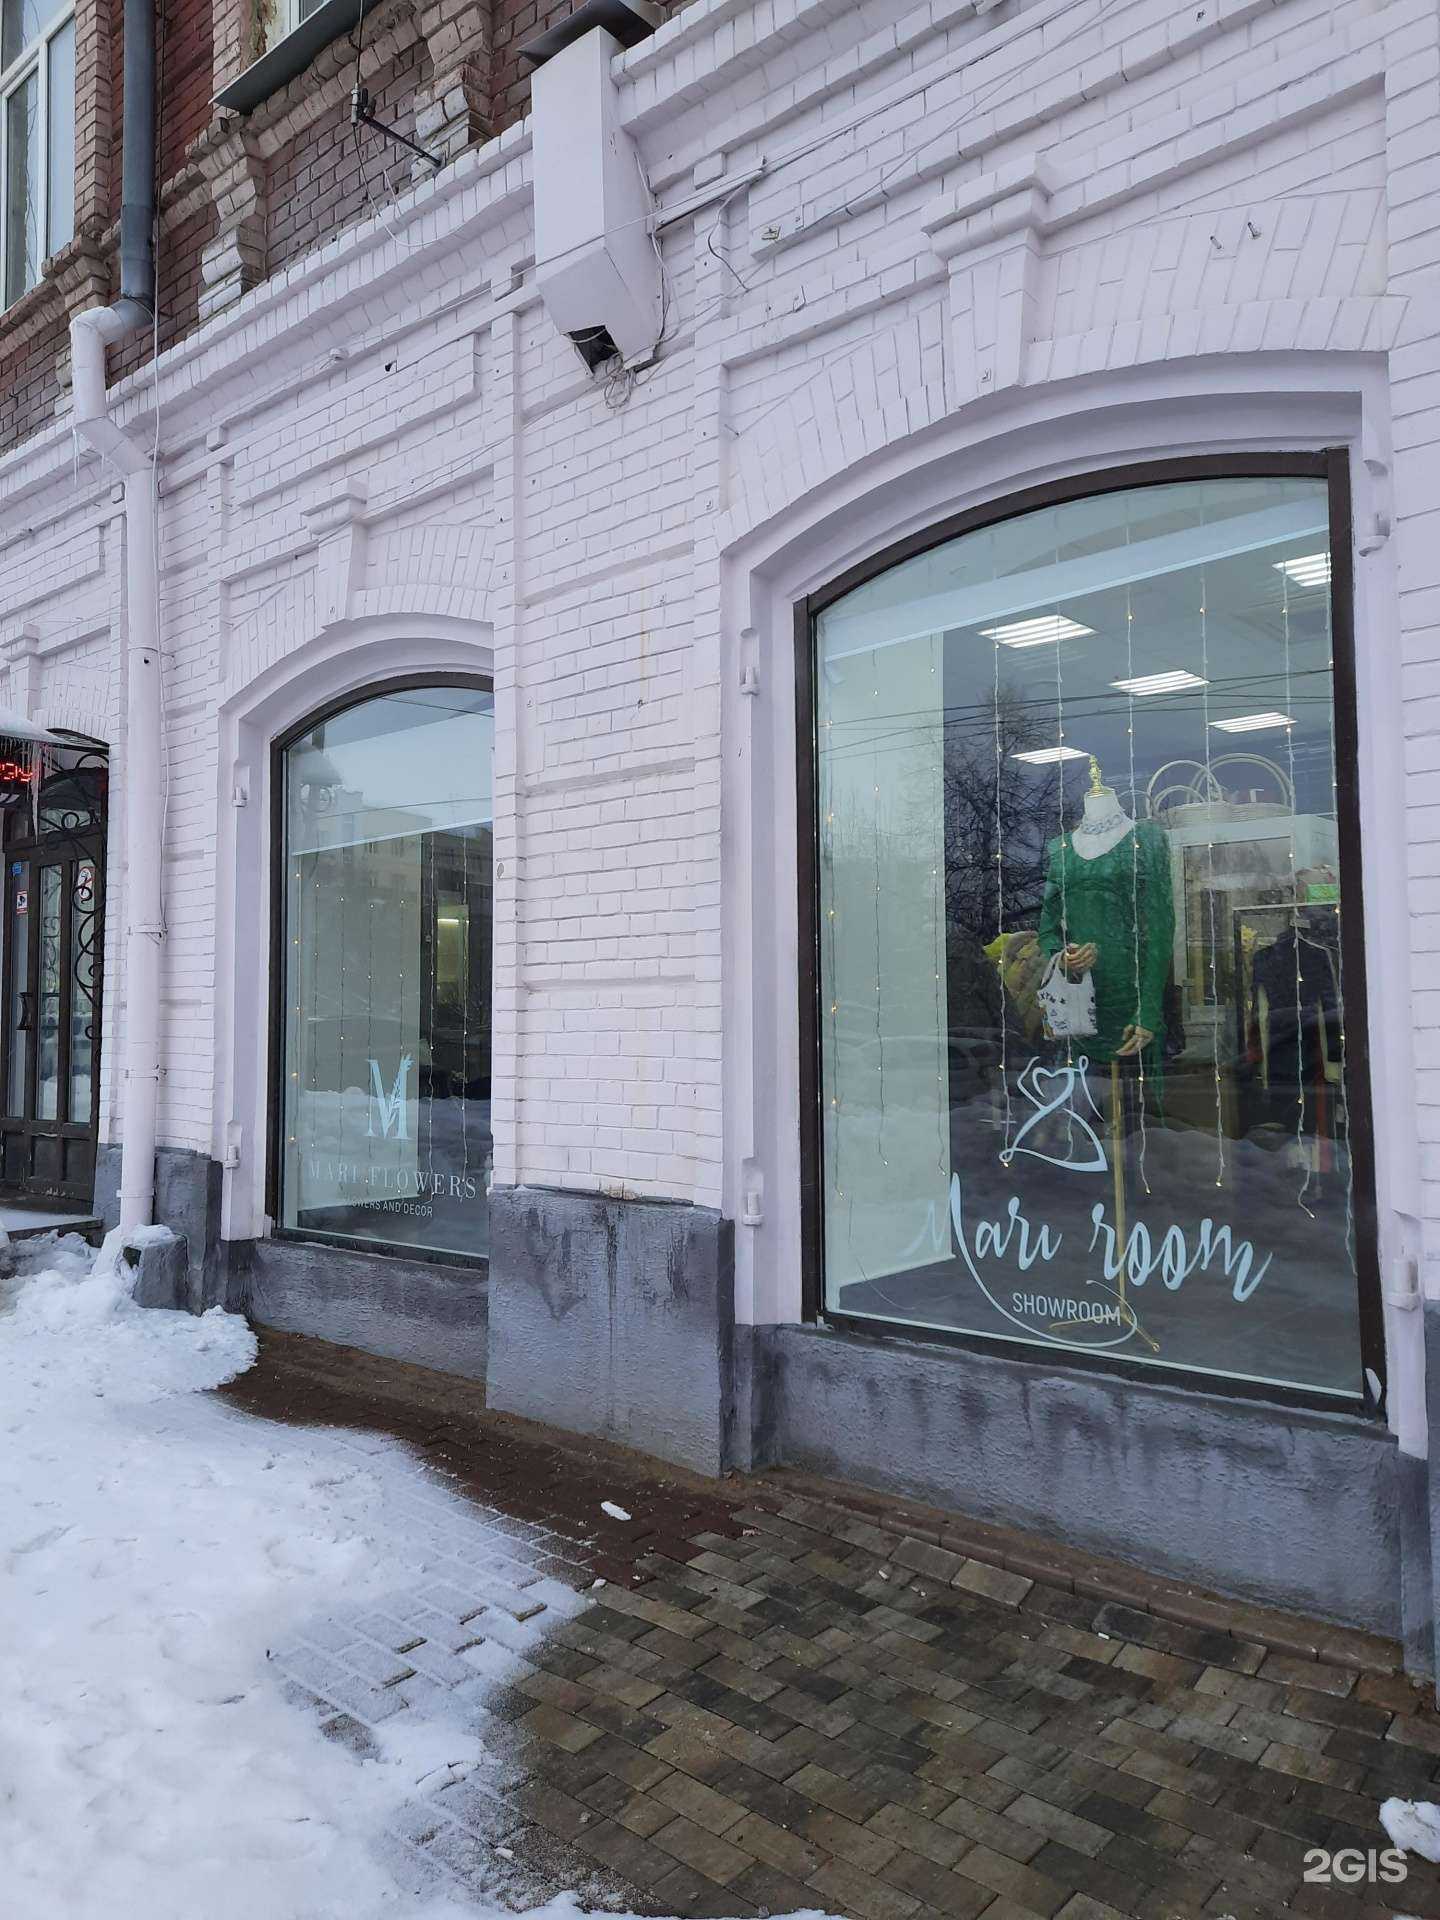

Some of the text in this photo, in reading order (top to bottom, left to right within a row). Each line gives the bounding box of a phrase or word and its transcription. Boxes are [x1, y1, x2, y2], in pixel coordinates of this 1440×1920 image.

[367, 1166, 477, 1200] FLOWERS
[382, 1201, 401, 1213] AND
[403, 1202, 433, 1218] DECOR
[1089, 1203, 1273, 1302] room
[1012, 1292, 1121, 1327] SHOWROOM
